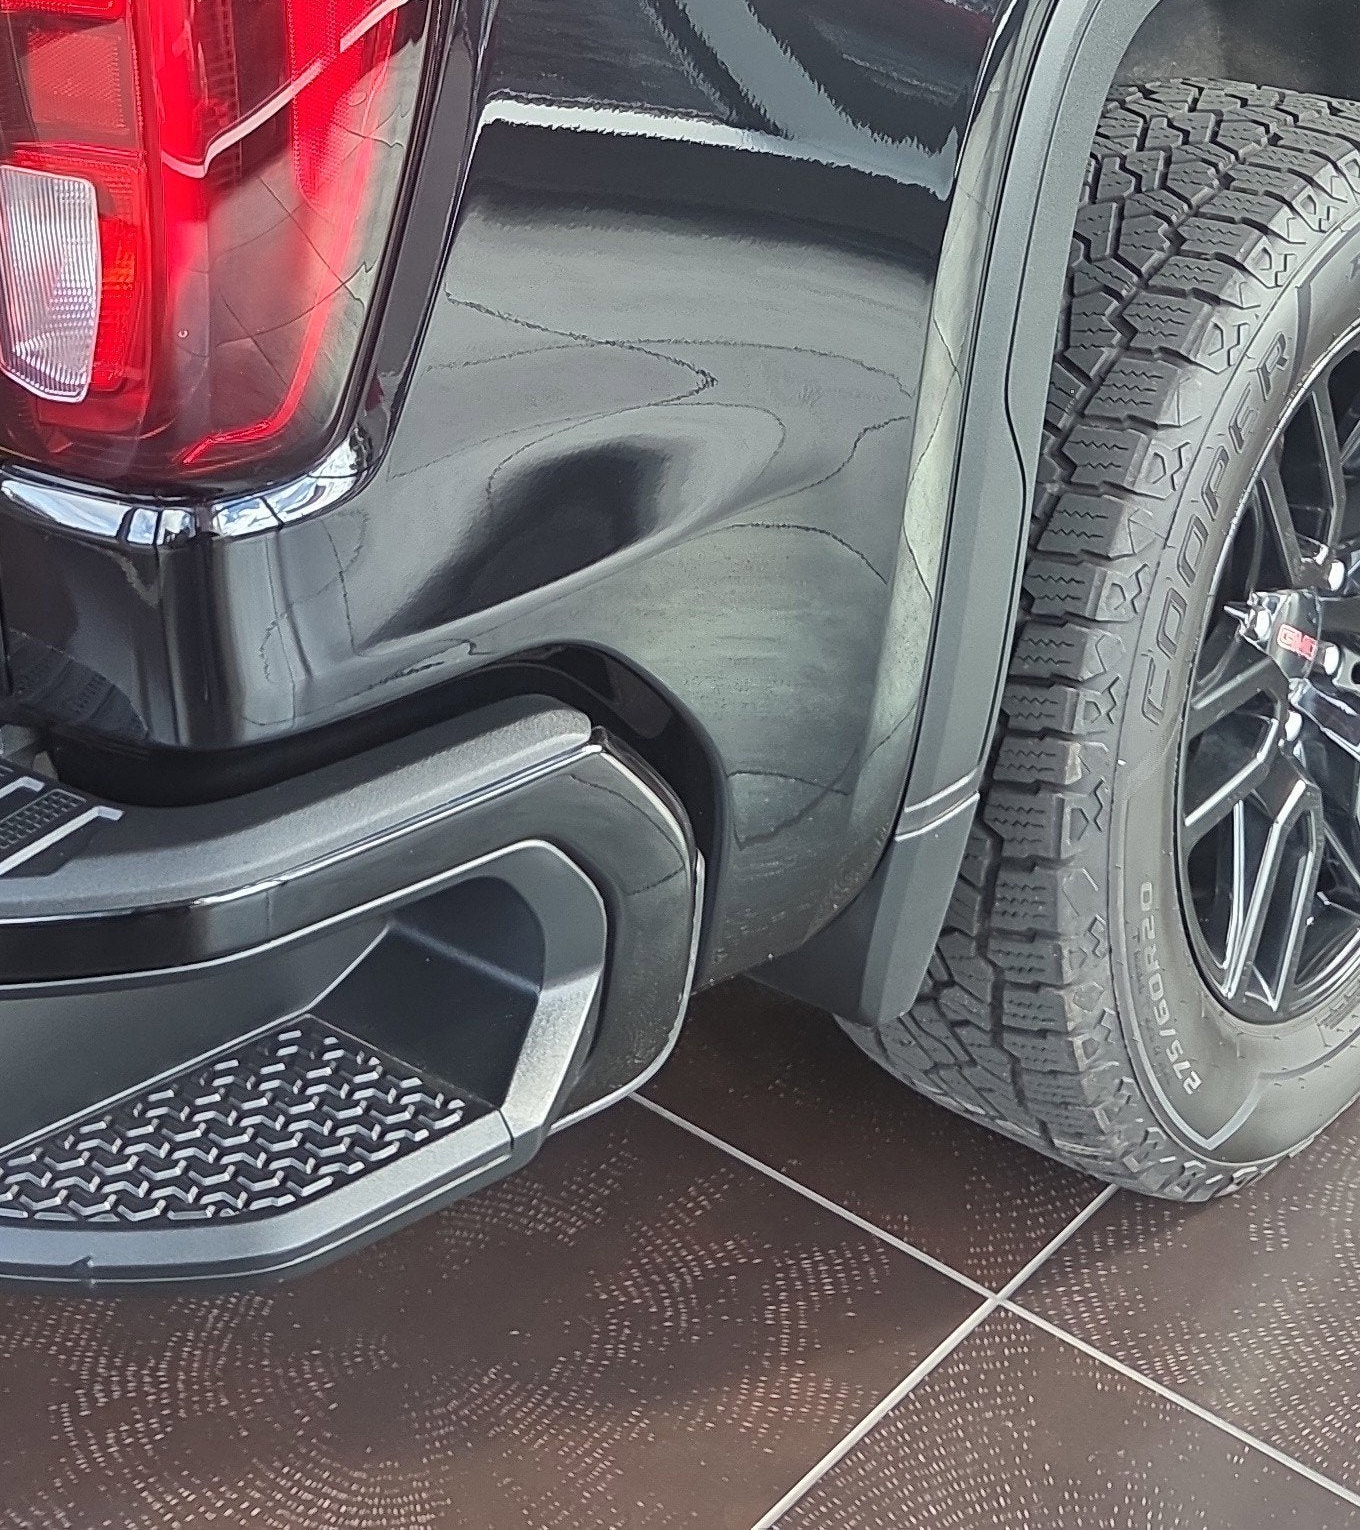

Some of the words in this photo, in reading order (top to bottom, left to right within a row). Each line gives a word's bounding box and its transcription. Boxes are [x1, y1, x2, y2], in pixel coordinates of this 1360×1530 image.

[1142, 331, 1288, 725] COOPER
[1277, 623, 1319, 661] GMC
[1141, 881, 1203, 1096] 275/60R20
